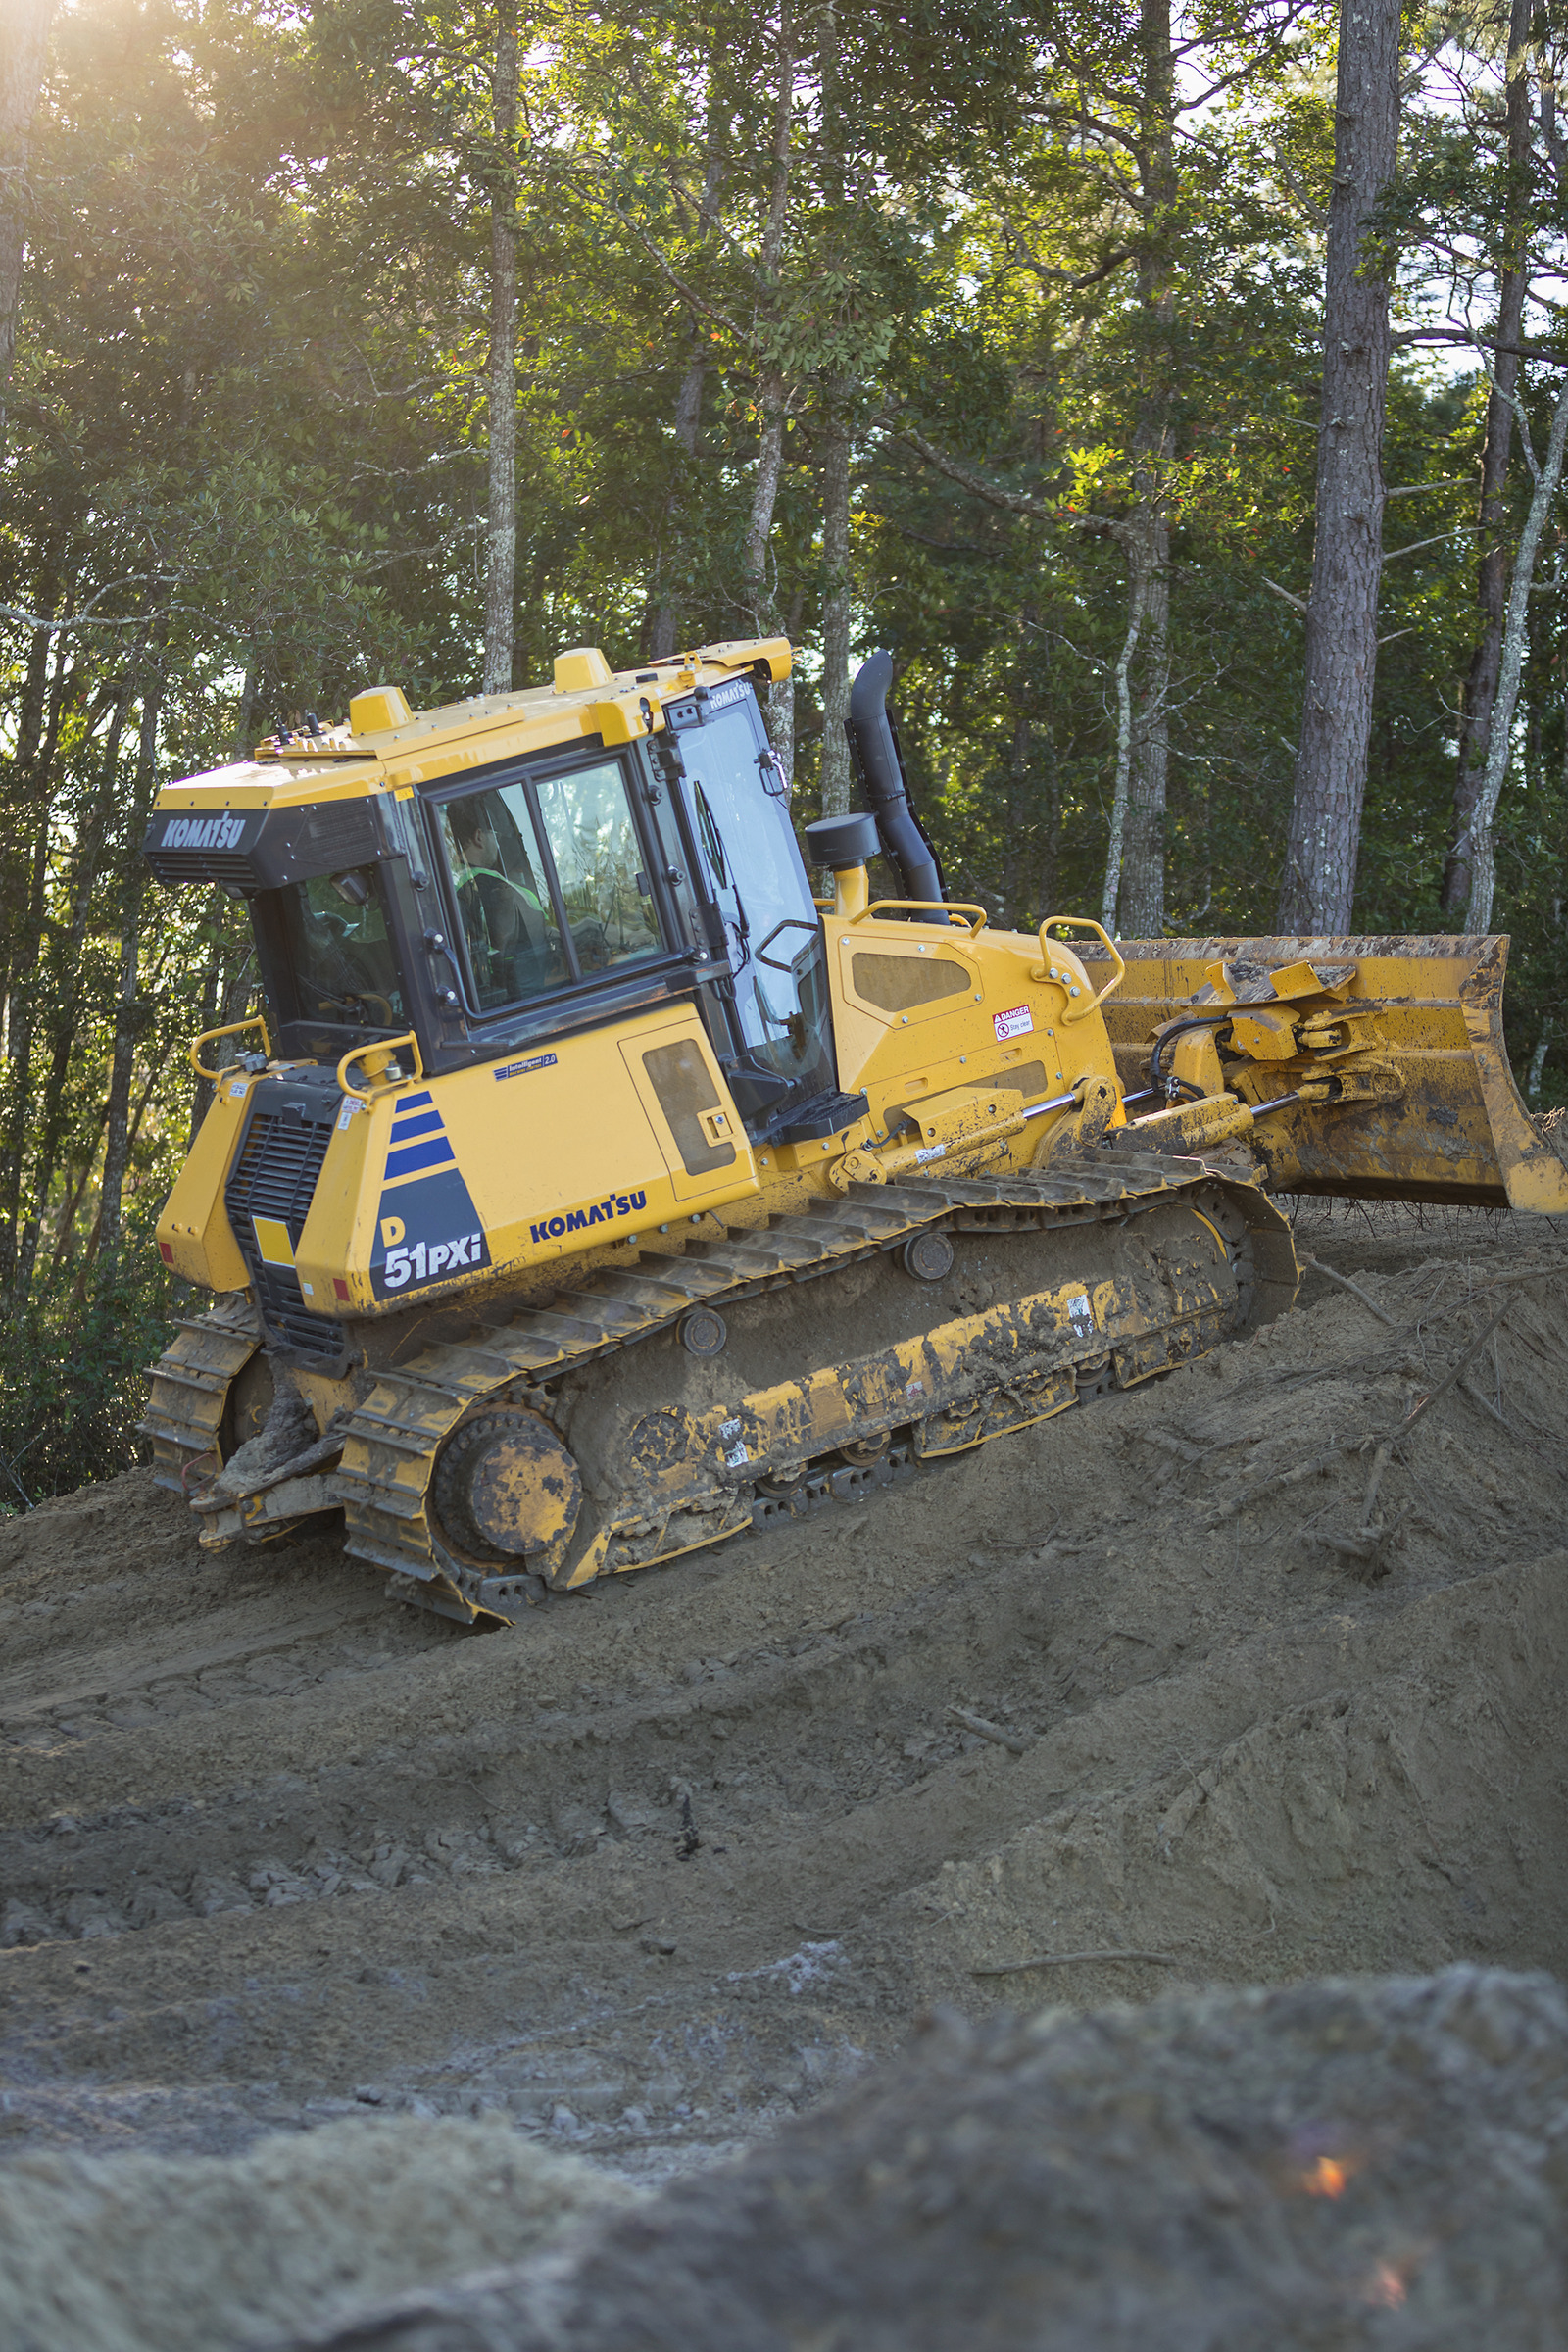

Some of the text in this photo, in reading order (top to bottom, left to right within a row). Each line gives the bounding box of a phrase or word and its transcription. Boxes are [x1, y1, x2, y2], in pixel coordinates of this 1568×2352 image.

[161, 811, 246, 849] KOMATSU
[1001, 1005, 1029, 1021] DANGER
[509, 1054, 556, 1072] Intelligent 2.0
[380, 1216, 406, 1248] D
[529, 1190, 647, 1244] KOMATSU
[384, 1233, 481, 1288] 51PXi
